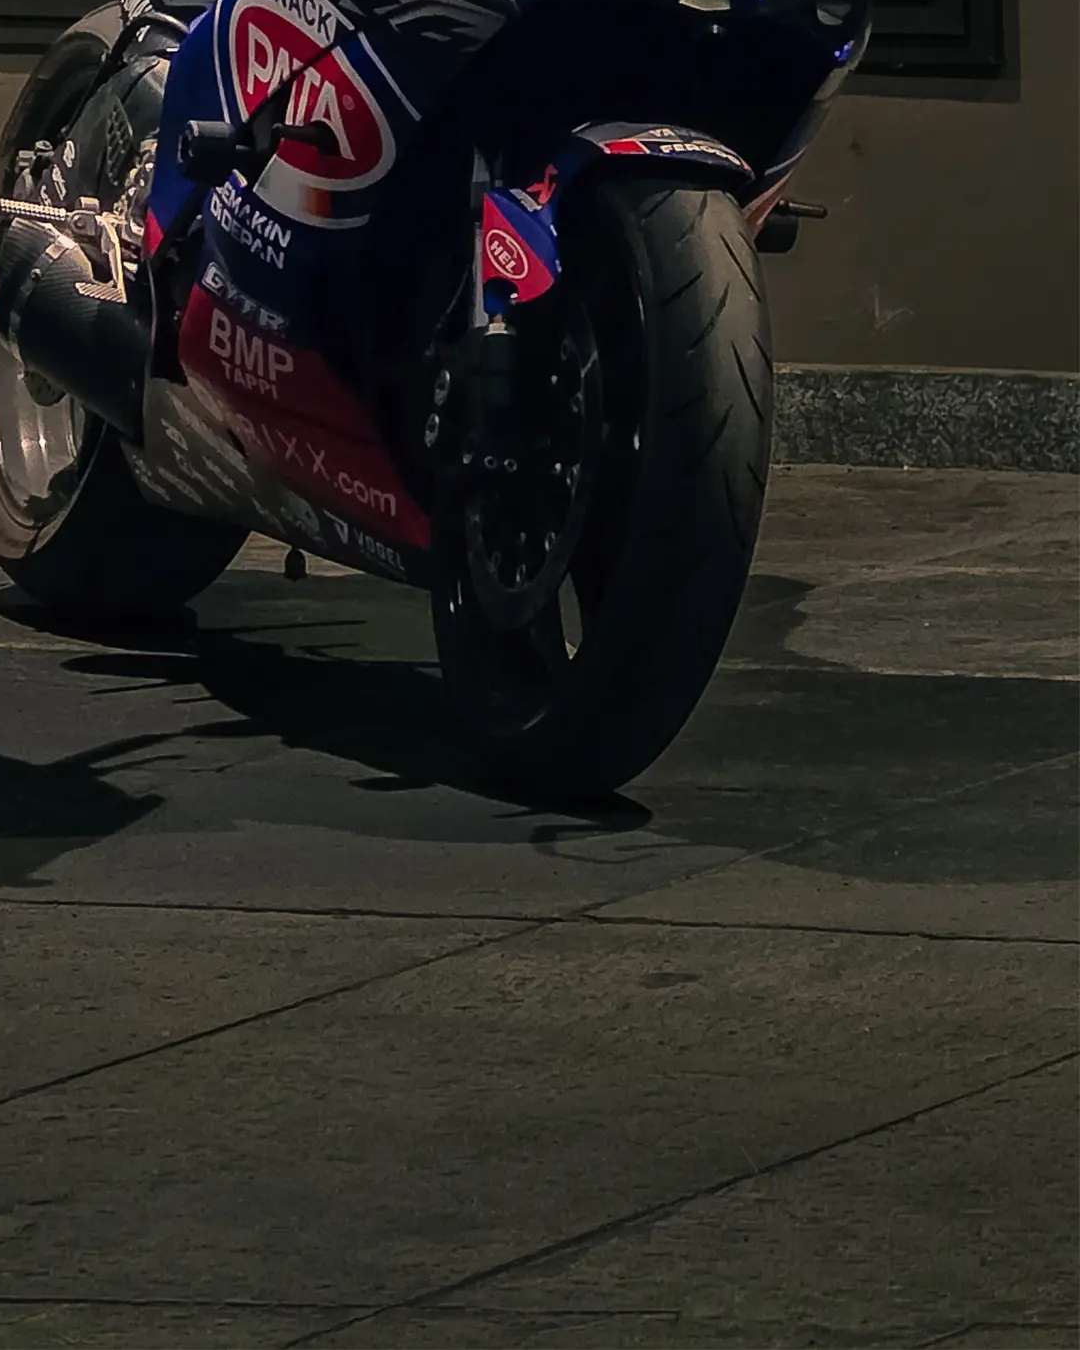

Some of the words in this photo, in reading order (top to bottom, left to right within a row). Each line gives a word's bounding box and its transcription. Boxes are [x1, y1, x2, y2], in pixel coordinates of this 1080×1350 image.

[247, 22, 356, 161] PATA
[490, 239, 517, 274] HEL
[209, 307, 295, 382] BMP
[221, 361, 280, 402] TAPPI
